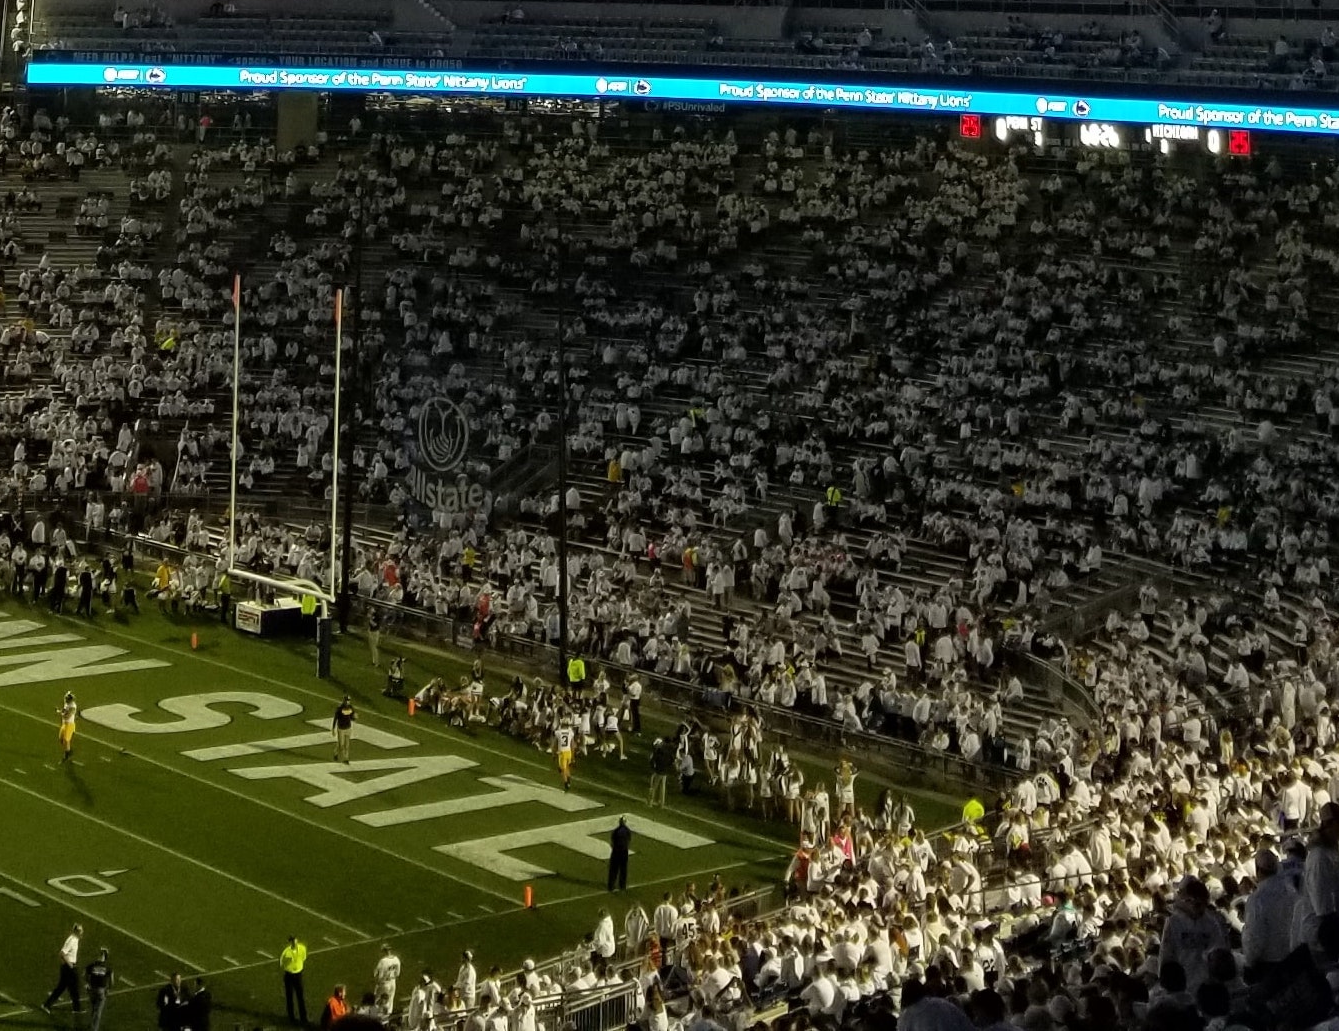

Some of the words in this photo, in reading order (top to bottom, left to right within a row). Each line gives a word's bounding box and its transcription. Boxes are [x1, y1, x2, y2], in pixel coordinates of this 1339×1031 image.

[73, 52, 100, 63] NEED
[308, 56, 358, 67] LOCATION
[360, 58, 379, 68] and
[382, 58, 412, 68] ISSUE
[239, 69, 278, 85] Proud
[279, 70, 330, 87] Sponsor
[332, 72, 347, 87] of
[347, 72, 370, 87] the
[371, 72, 404, 87] Penn
[443, 74, 490, 93] Nittany
[719, 83, 754, 98] Proud
[755, 84, 801, 101] Sponsor
[802, 86, 815, 100] of
[815, 87, 835, 101] the
[835, 87, 864, 101] Penn
[897, 91, 939, 110] Nittany
[662, 101, 726, 114] #PSUnrivaled
[1158, 103, 1194, 121] Proud
[1195, 106, 1246, 125] Sponsor
[1247, 109, 1262, 124] of
[1262, 110, 1284, 126] the
[1285, 112, 1318, 128] Penn
[562, 736, 569, 747] 3
[80, 691, 717, 881] STATE
[682, 922, 695, 940] 45
